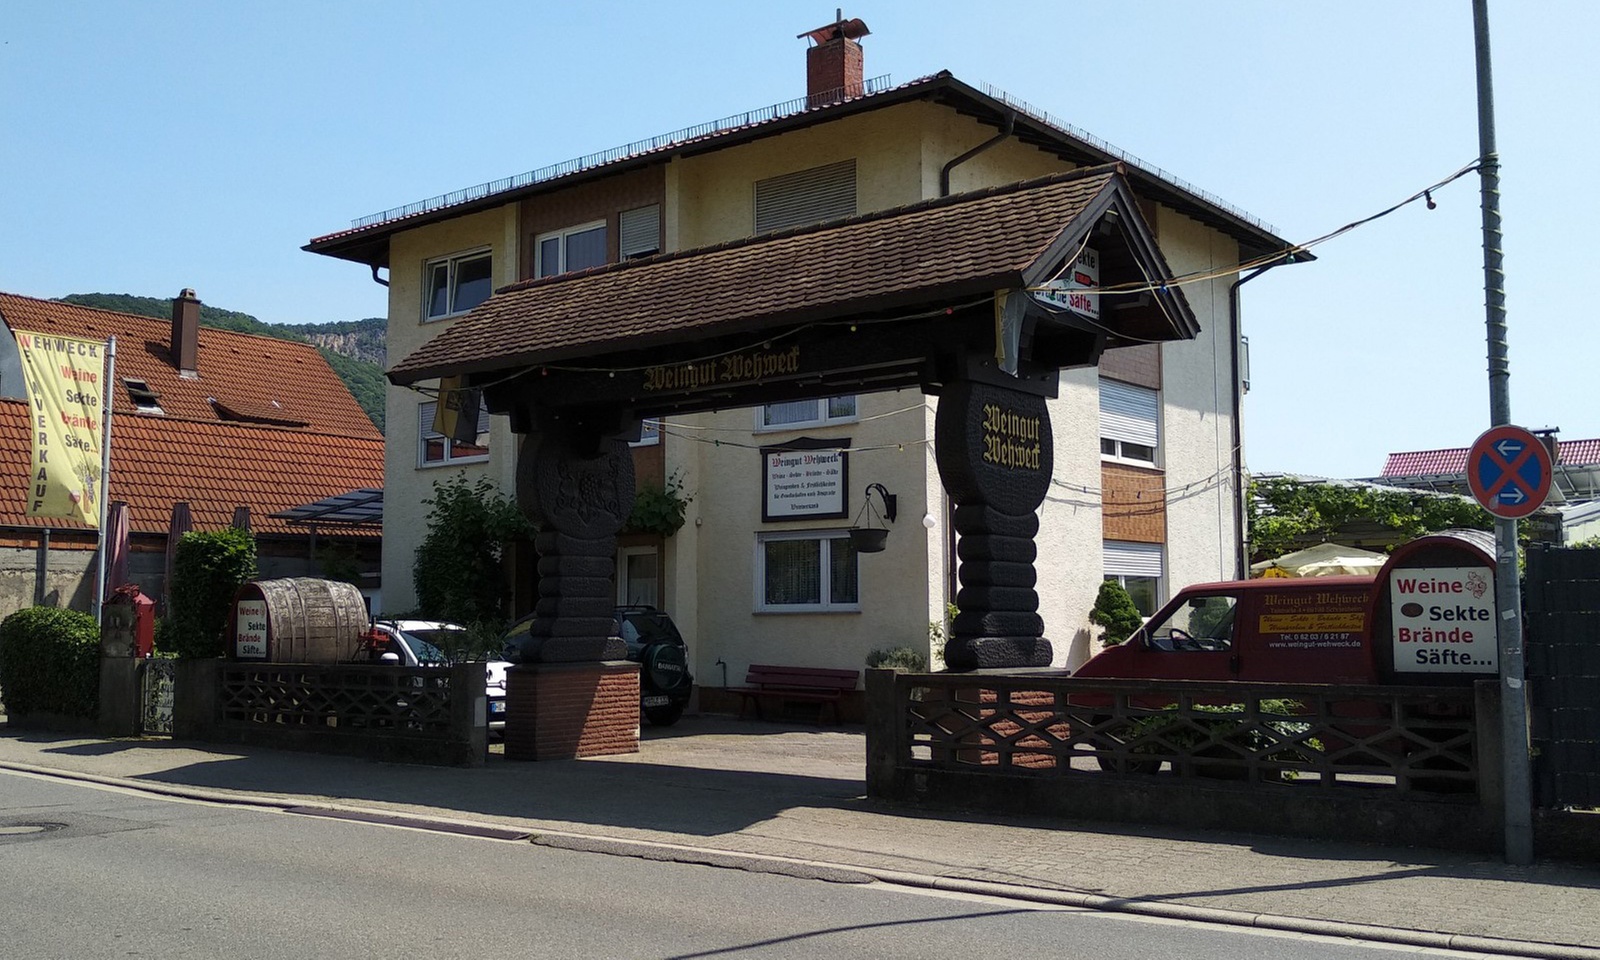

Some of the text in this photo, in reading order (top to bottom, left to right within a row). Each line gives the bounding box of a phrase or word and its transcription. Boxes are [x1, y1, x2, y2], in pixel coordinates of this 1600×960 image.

[1077, 249, 1095, 268] ekte
[643, 360, 717, 391] Weingut
[66, 389, 97, 407] Sekte
[983, 403, 1040, 443] Weingut
[983, 434, 1041, 470] Wehweck
[772, 453, 839, 468] Weingut Wehweck
[1397, 578, 1463, 594] Weine
[1264, 592, 1369, 607] Weingut Wehweck
[240, 607, 258, 615] Weine
[1429, 605, 1490, 621] Sekte
[248, 622, 265, 631] Sekte
[1398, 626, 1474, 643] Brände
[239, 634, 260, 642] Brände
[1268, 641, 1362, 649] www.weingut-wehweck.de
[1416, 648, 1492, 666] Säfte...
